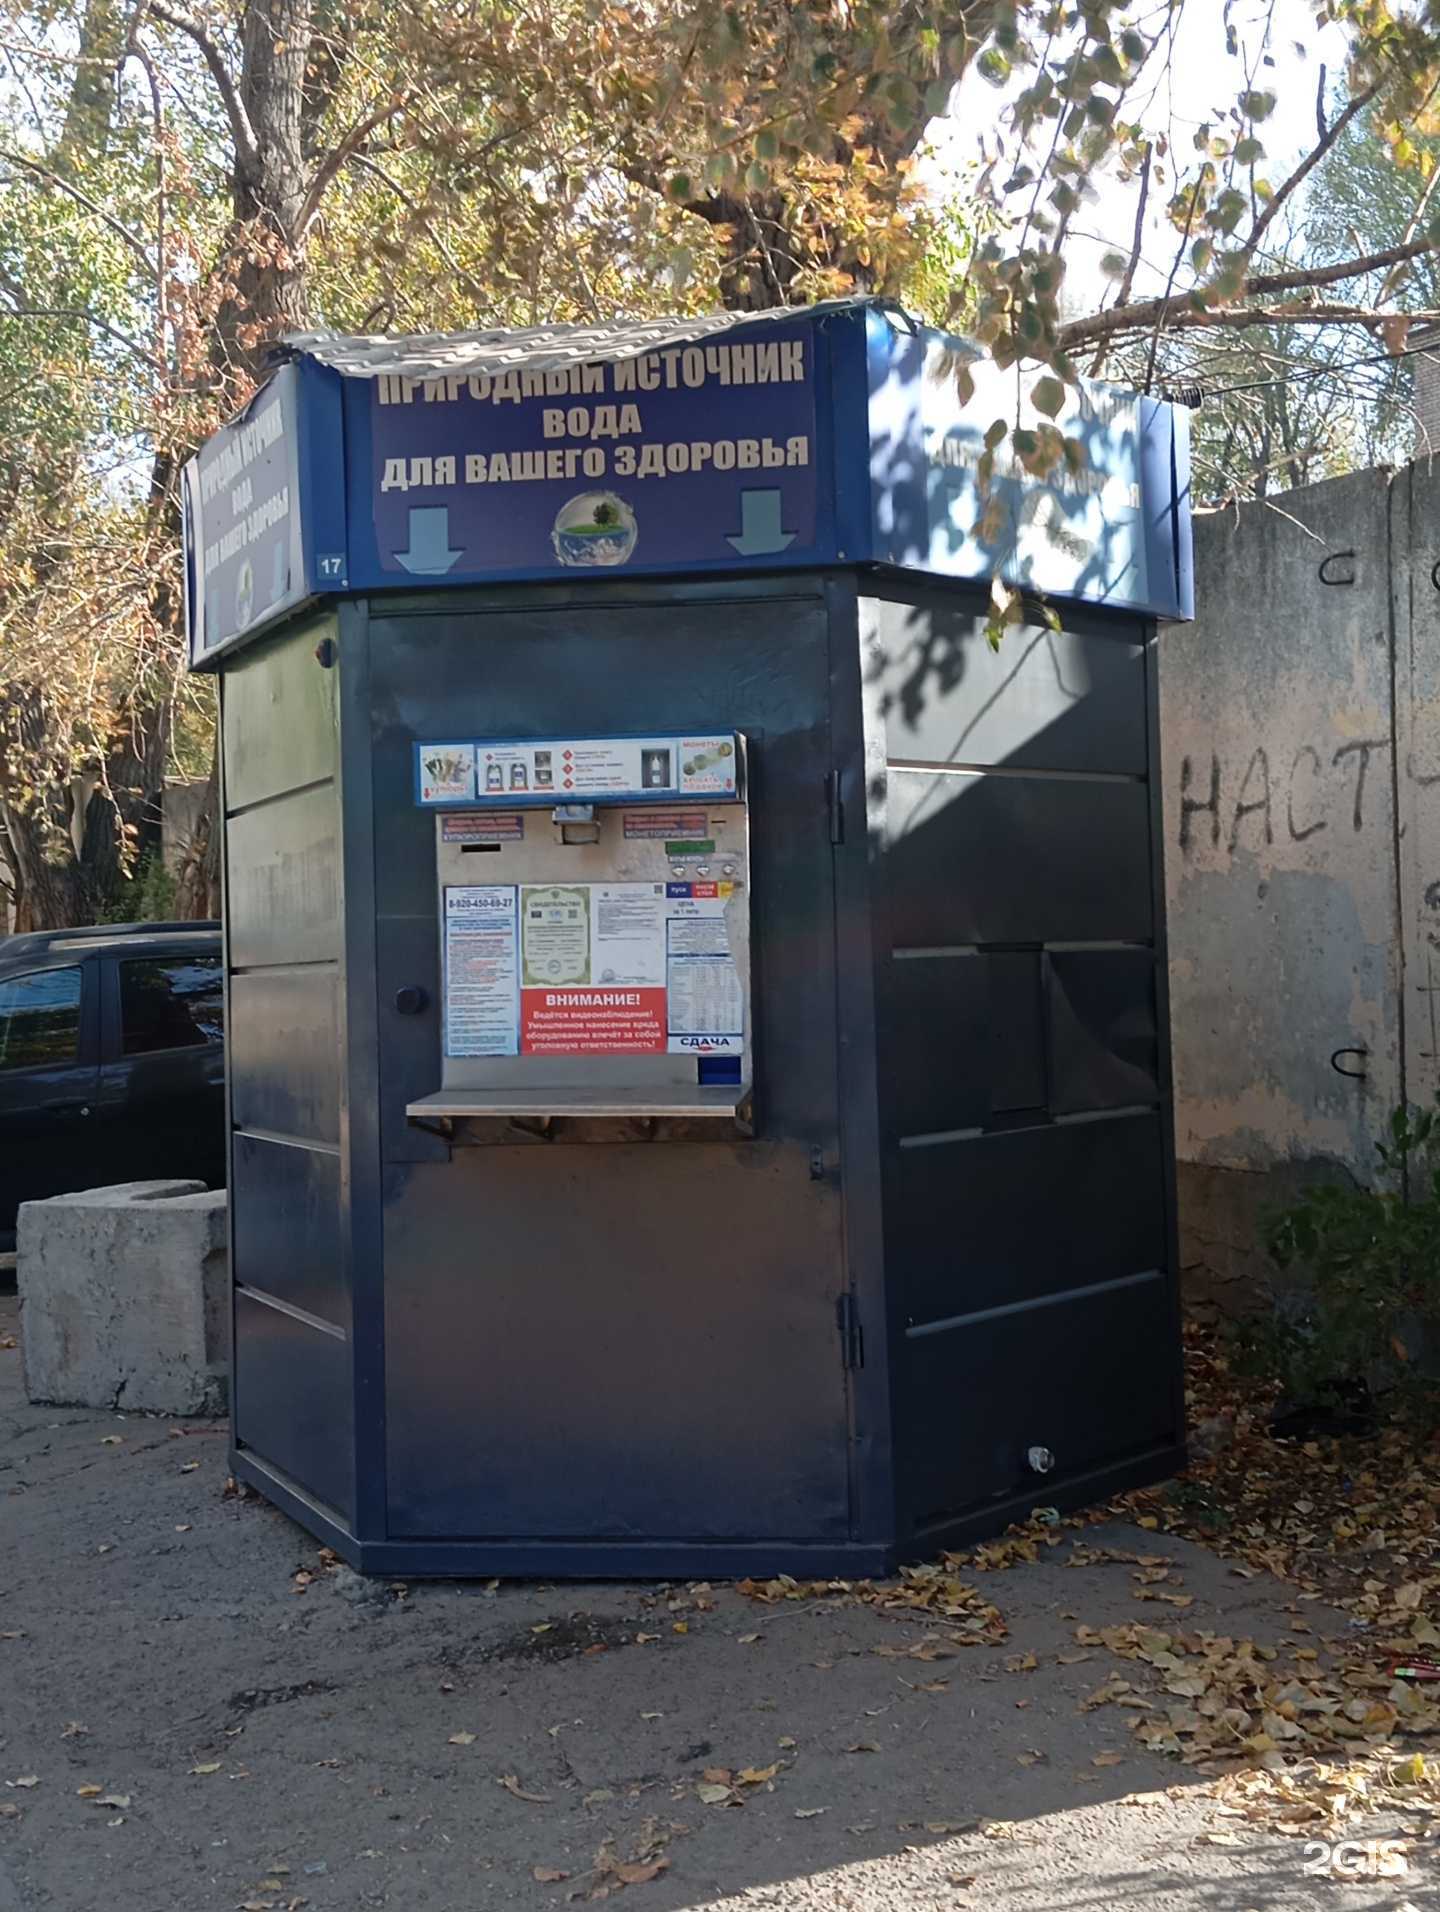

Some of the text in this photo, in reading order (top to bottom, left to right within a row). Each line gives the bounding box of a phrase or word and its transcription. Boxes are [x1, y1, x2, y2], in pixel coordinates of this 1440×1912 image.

[614, 341, 804, 392] ИСТОЧНИК
[542, 403, 643, 440] ВОДА
[381, 436, 809, 492] ДЛЯ ВАШЕГО ЗДОРОВЬЯ
[321, 558, 342, 575] 17
[545, 993, 641, 1006] ВНИМАНИЕ!
[533, 1010, 653, 1019] Ведётся видеонаблюдение!
[528, 1021, 584, 1030] Умышленное
[586, 1021, 631, 1029] нанесение
[635, 1030, 661, 1038] собой
[580, 1040, 656, 1049] ответственность!
[680, 1037, 730, 1047] СДАЧА
